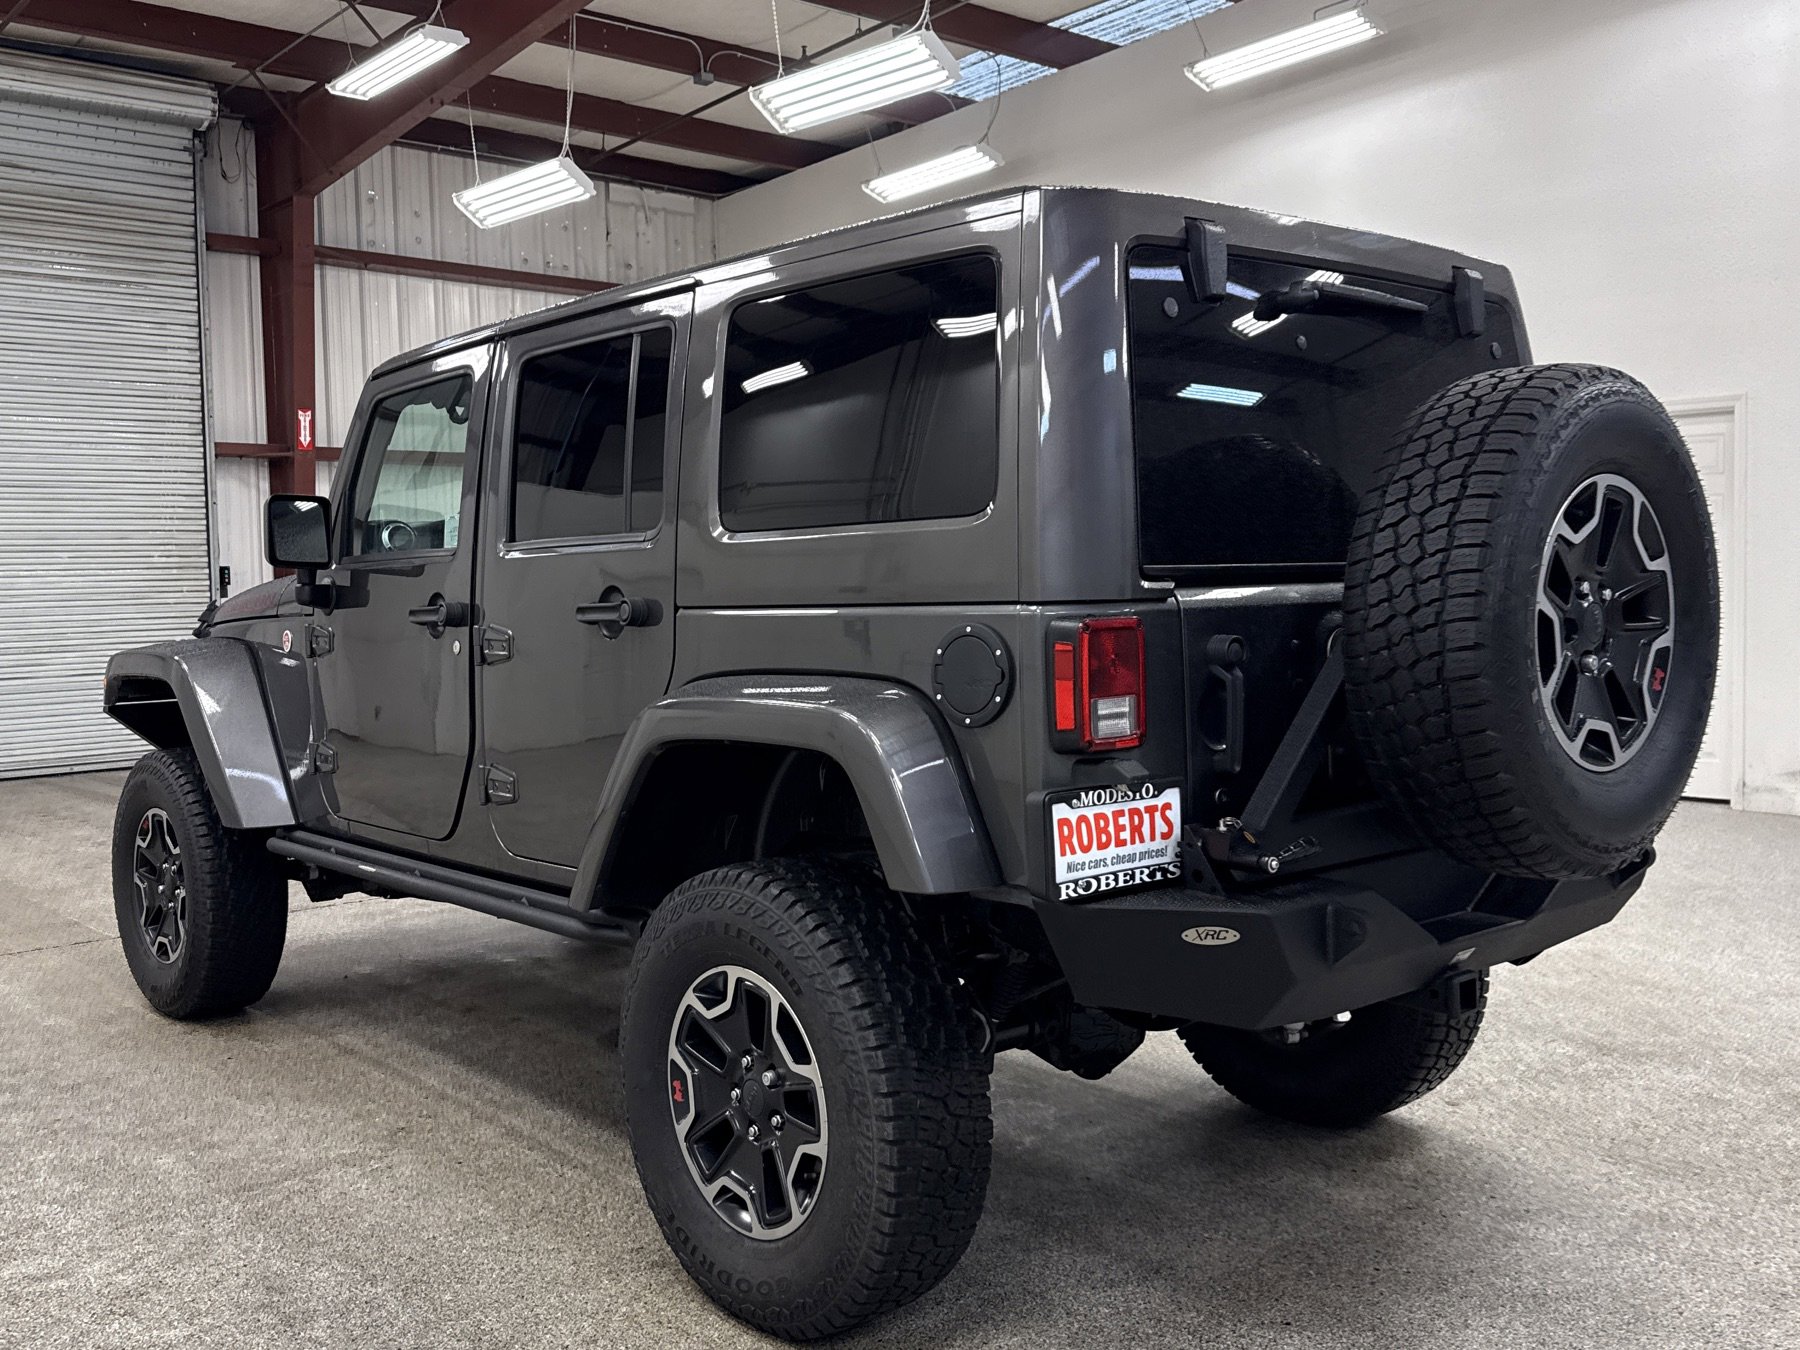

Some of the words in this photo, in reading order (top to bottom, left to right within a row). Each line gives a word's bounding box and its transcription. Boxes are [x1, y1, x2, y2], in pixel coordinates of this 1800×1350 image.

[1057, 802, 1174, 857] ROBERTS
[1066, 860, 1086, 875] Nice
[1087, 857, 1109, 870] cars,
[1111, 852, 1137, 867] cheap
[1139, 845, 1168, 862] prices!
[1059, 863, 1181, 900] ROBERTS
[1192, 929, 1229, 941] XRC
[723, 922, 804, 997] LEGEND
